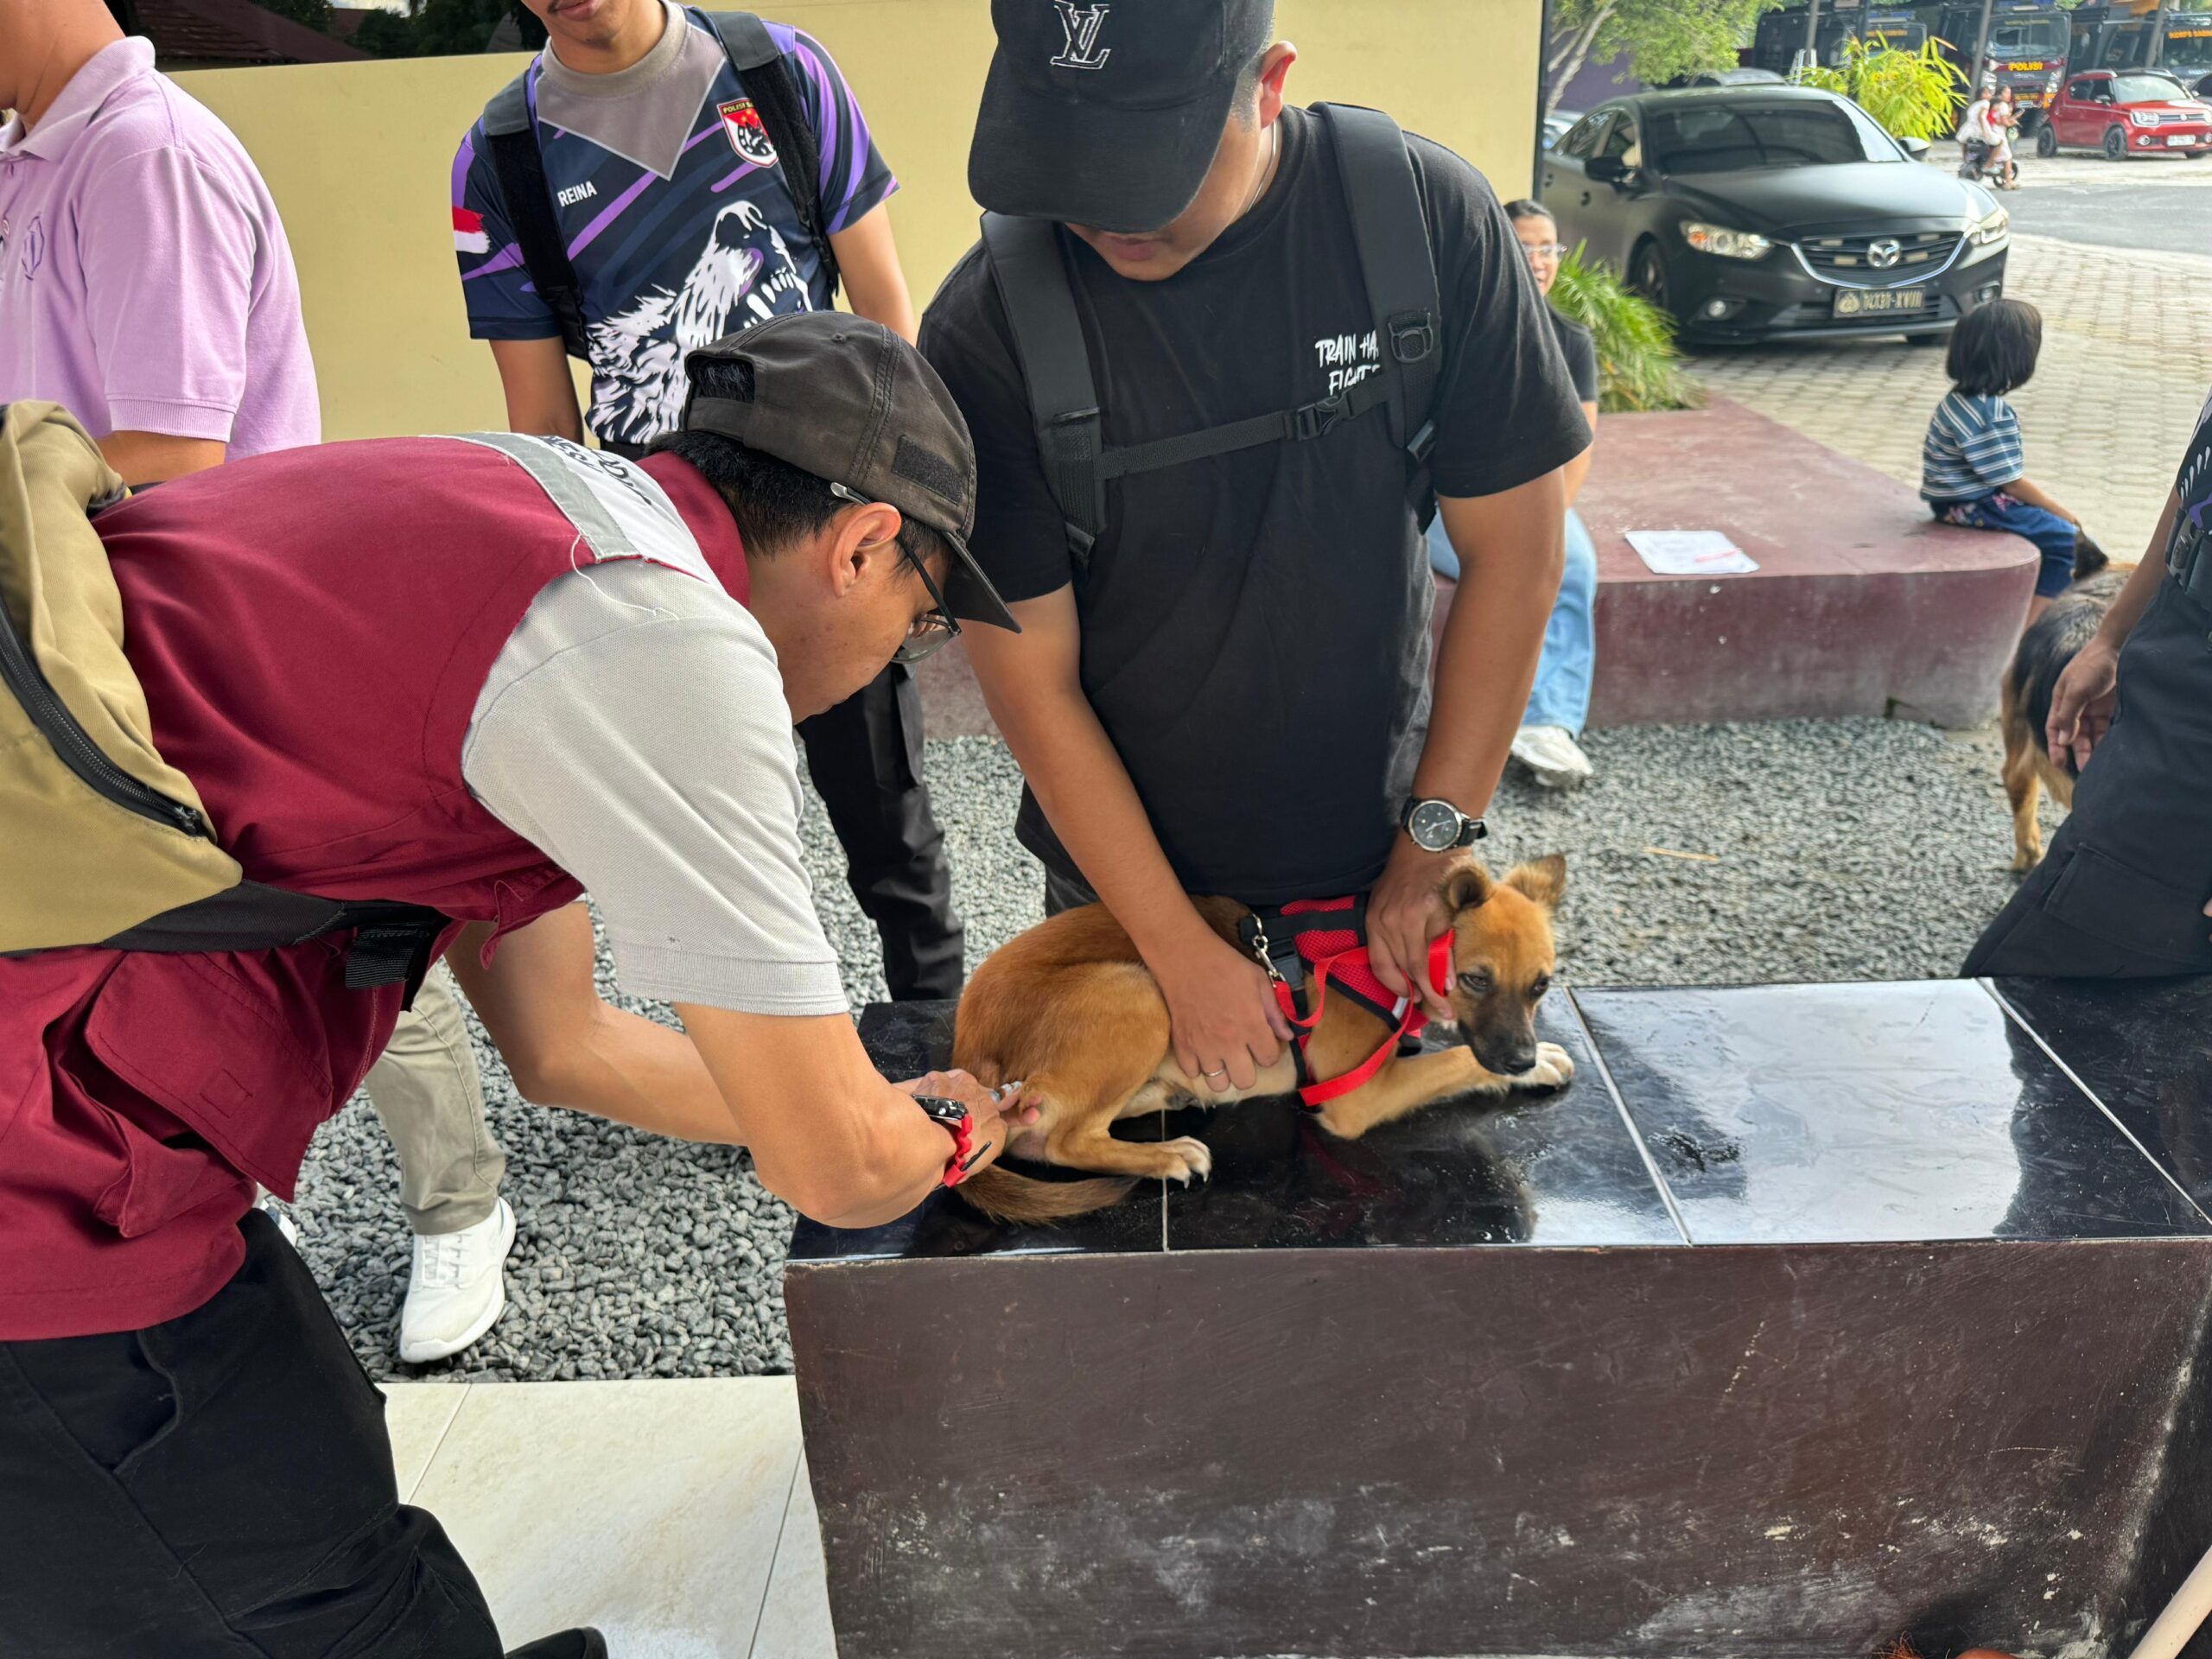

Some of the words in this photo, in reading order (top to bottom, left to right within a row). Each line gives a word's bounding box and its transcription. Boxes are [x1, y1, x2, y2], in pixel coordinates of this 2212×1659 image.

[2008, 61, 2044, 71] POLISI
[722, 103, 746, 114] POLISI
[557, 181, 597, 207] REINA
[1315, 334, 1357, 368] TRAIN
